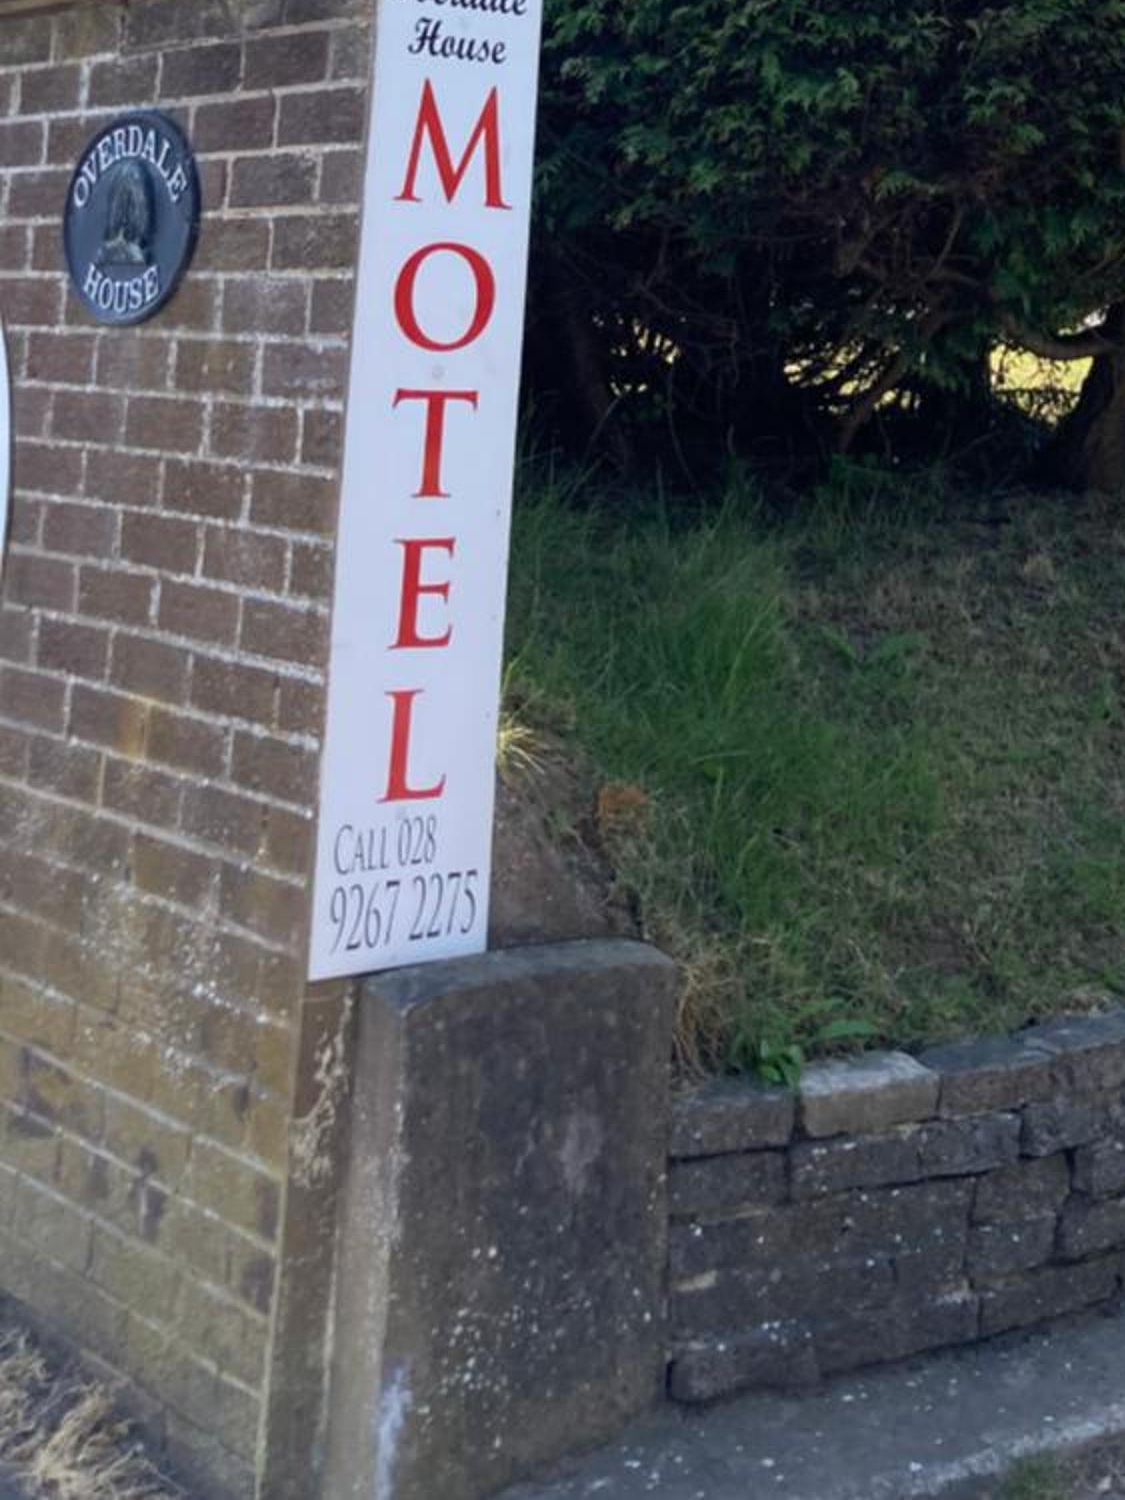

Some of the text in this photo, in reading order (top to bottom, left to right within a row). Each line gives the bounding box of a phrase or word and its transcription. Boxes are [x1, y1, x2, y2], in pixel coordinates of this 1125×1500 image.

[408, 16, 507, 64] House
[72, 124, 188, 208] OVERDALE
[83, 262, 160, 313] HOUSE
[376, 76, 514, 804] MOTEL
[333, 814, 437, 876] CALL 028
[330, 868, 478, 956] 9267 2275
